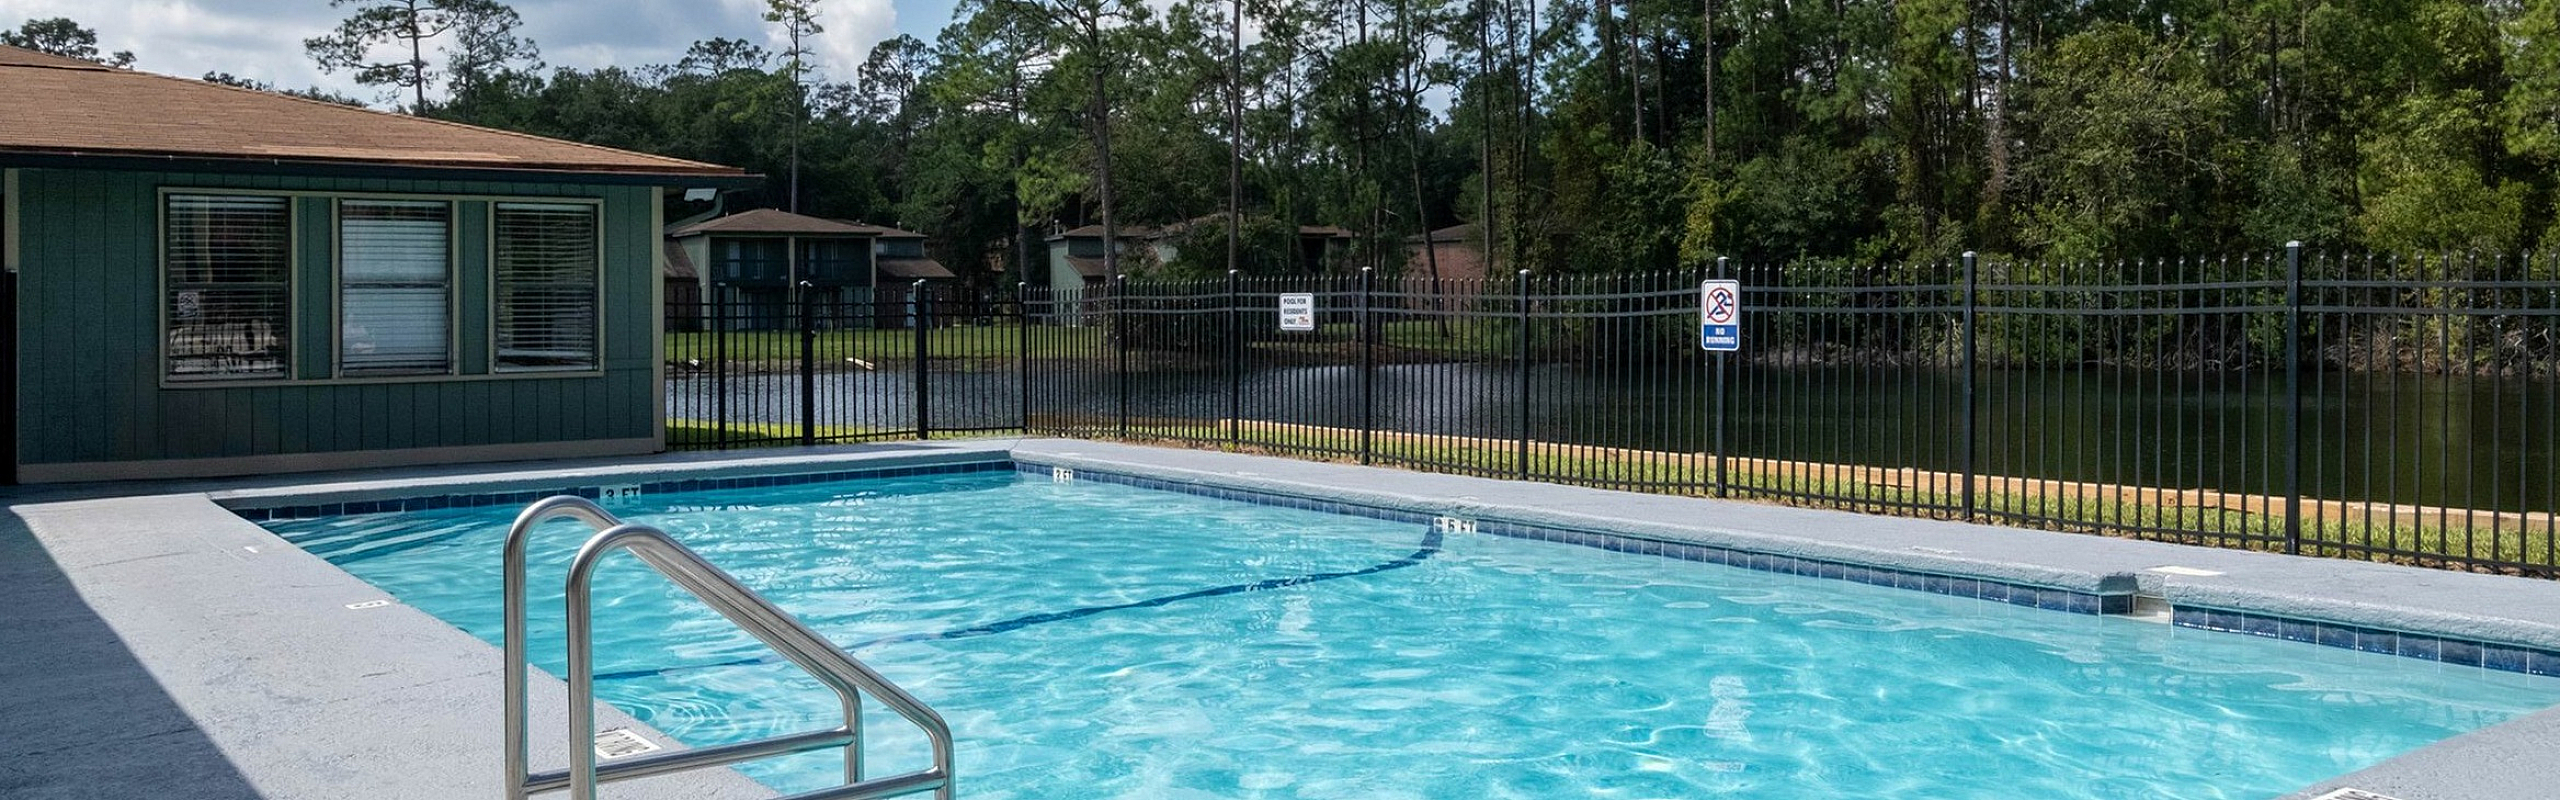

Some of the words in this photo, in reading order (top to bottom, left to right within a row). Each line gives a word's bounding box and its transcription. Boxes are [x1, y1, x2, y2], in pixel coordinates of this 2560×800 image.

[1283, 297, 1296, 305] POOL
[1297, 297, 1307, 305] FOR
[1283, 307, 1308, 315] RESIDENTS
[1283, 317, 1296, 325] ONLY
[1715, 327, 1726, 336] NO
[1706, 336, 1735, 345] RUNNING
[621, 487, 639, 497] FT
